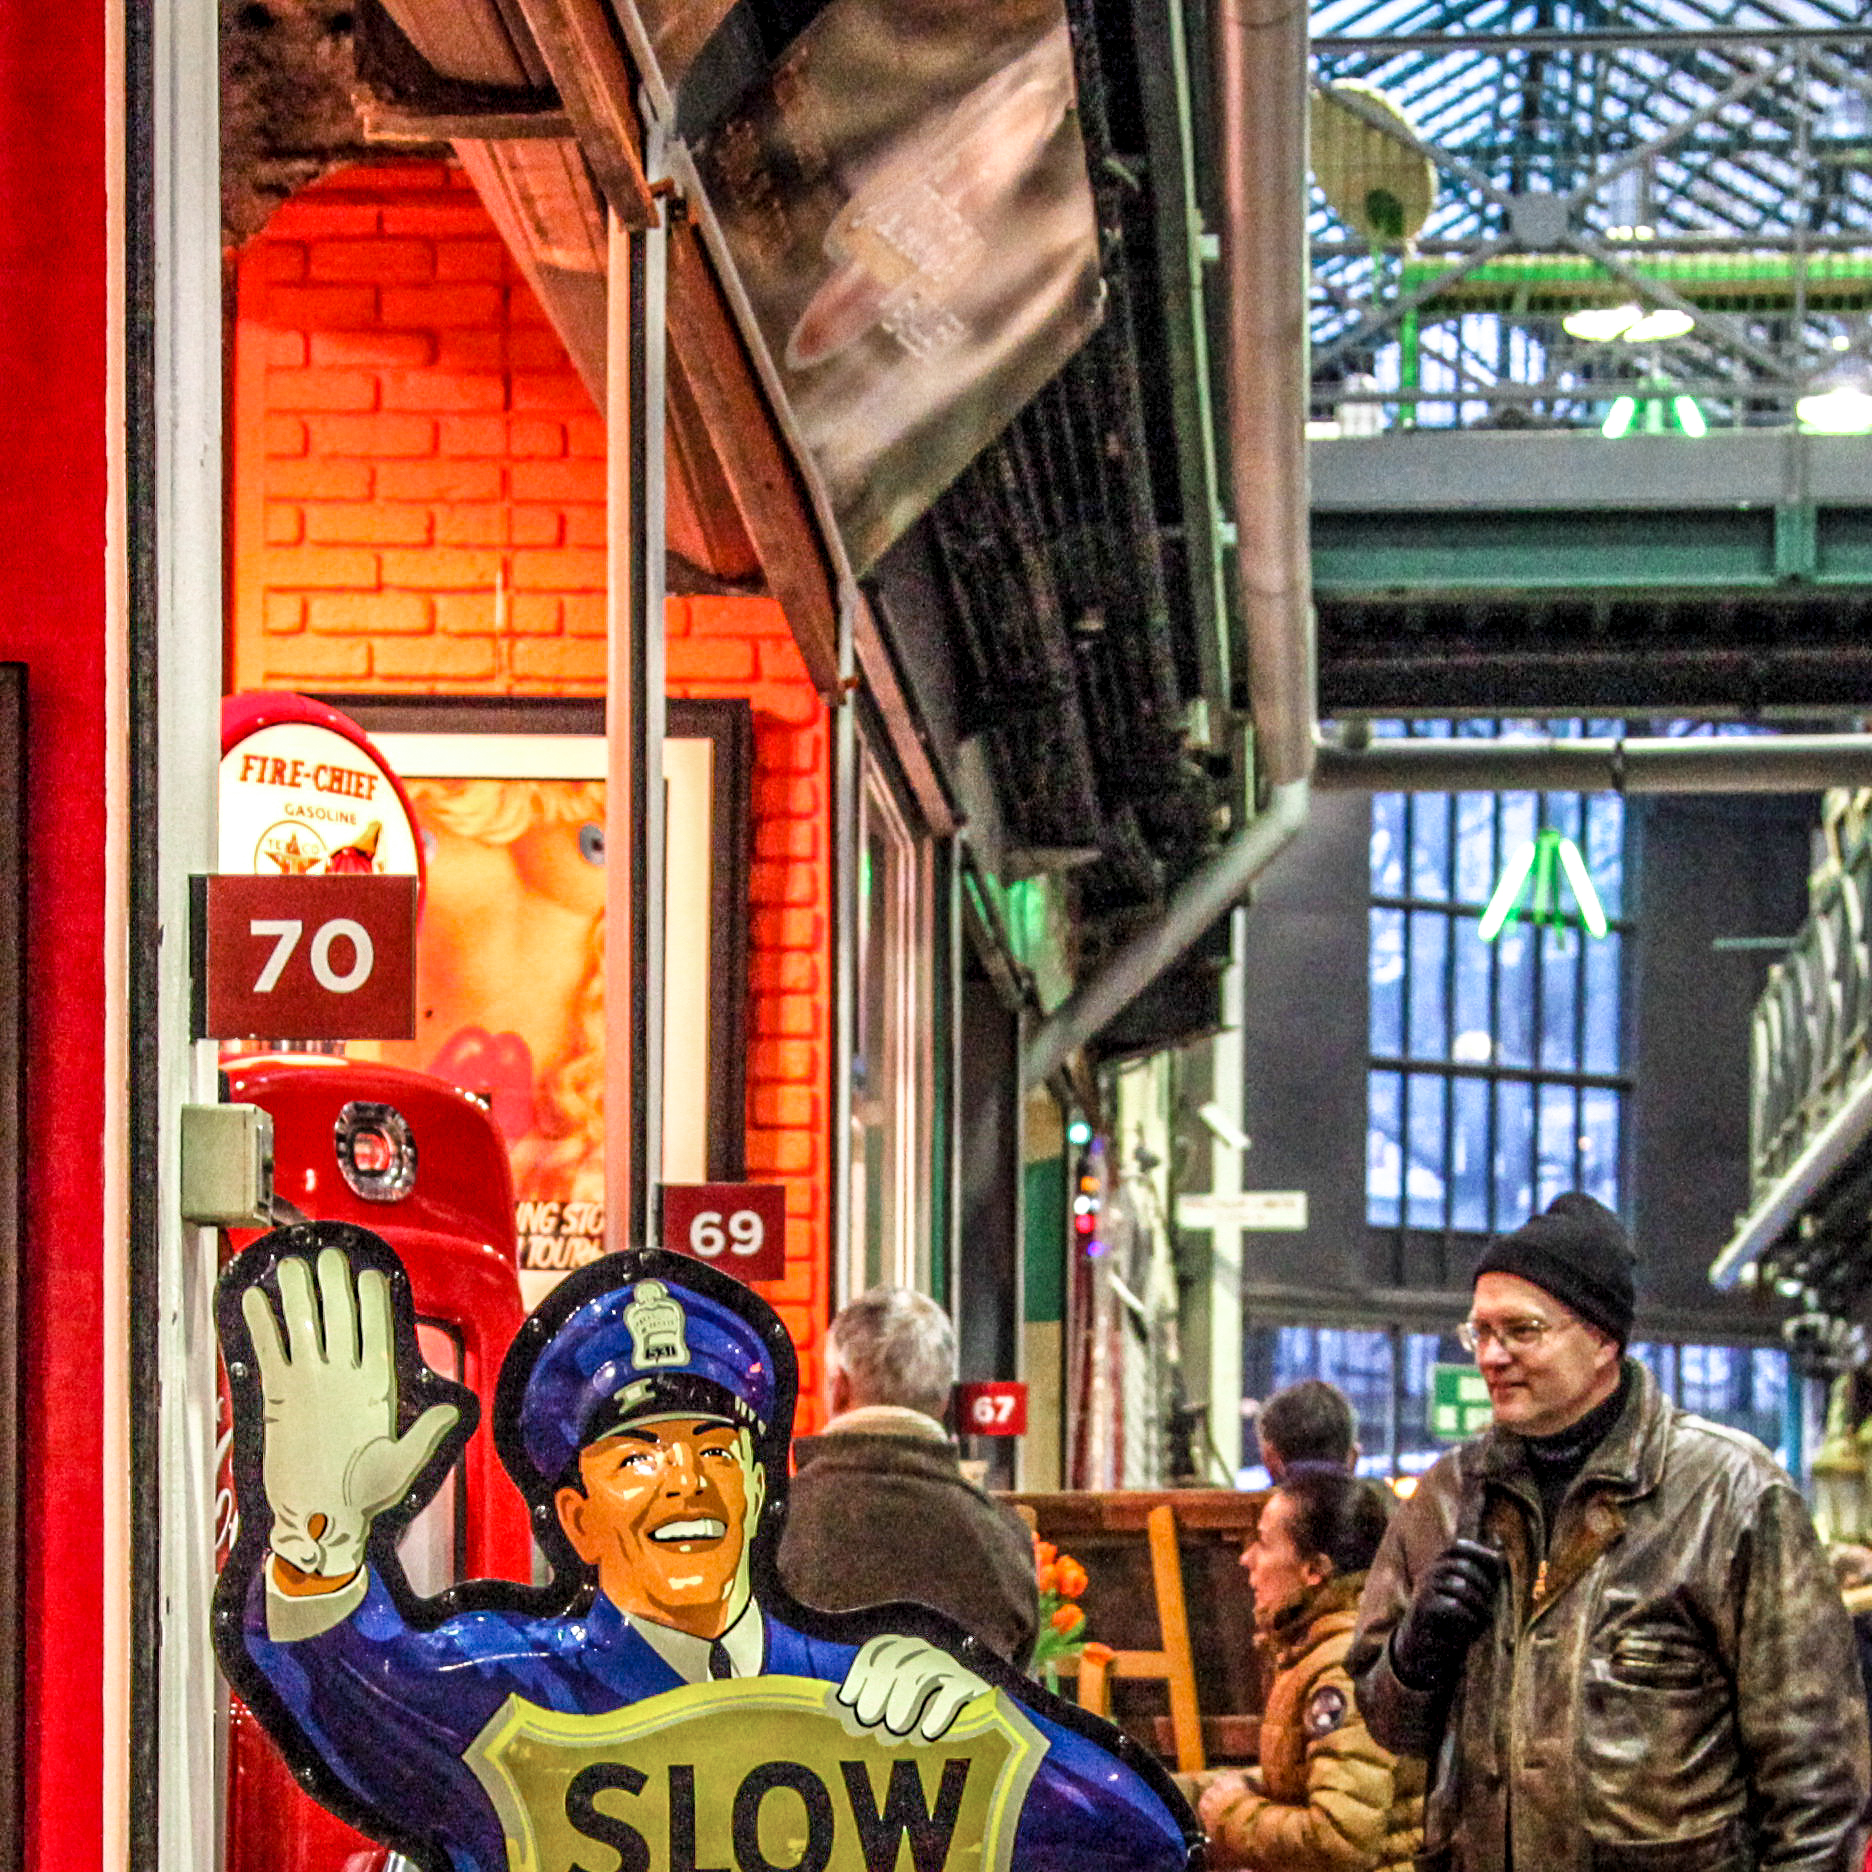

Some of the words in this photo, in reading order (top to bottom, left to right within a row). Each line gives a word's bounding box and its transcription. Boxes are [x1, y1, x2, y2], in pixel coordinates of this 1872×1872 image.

[239, 754, 379, 801] FIRE-CHIEF
[284, 803, 357, 825] GASOLINE
[250, 918, 375, 994] 70
[689, 1209, 765, 1258] 69
[972, 1395, 1016, 1424] 67
